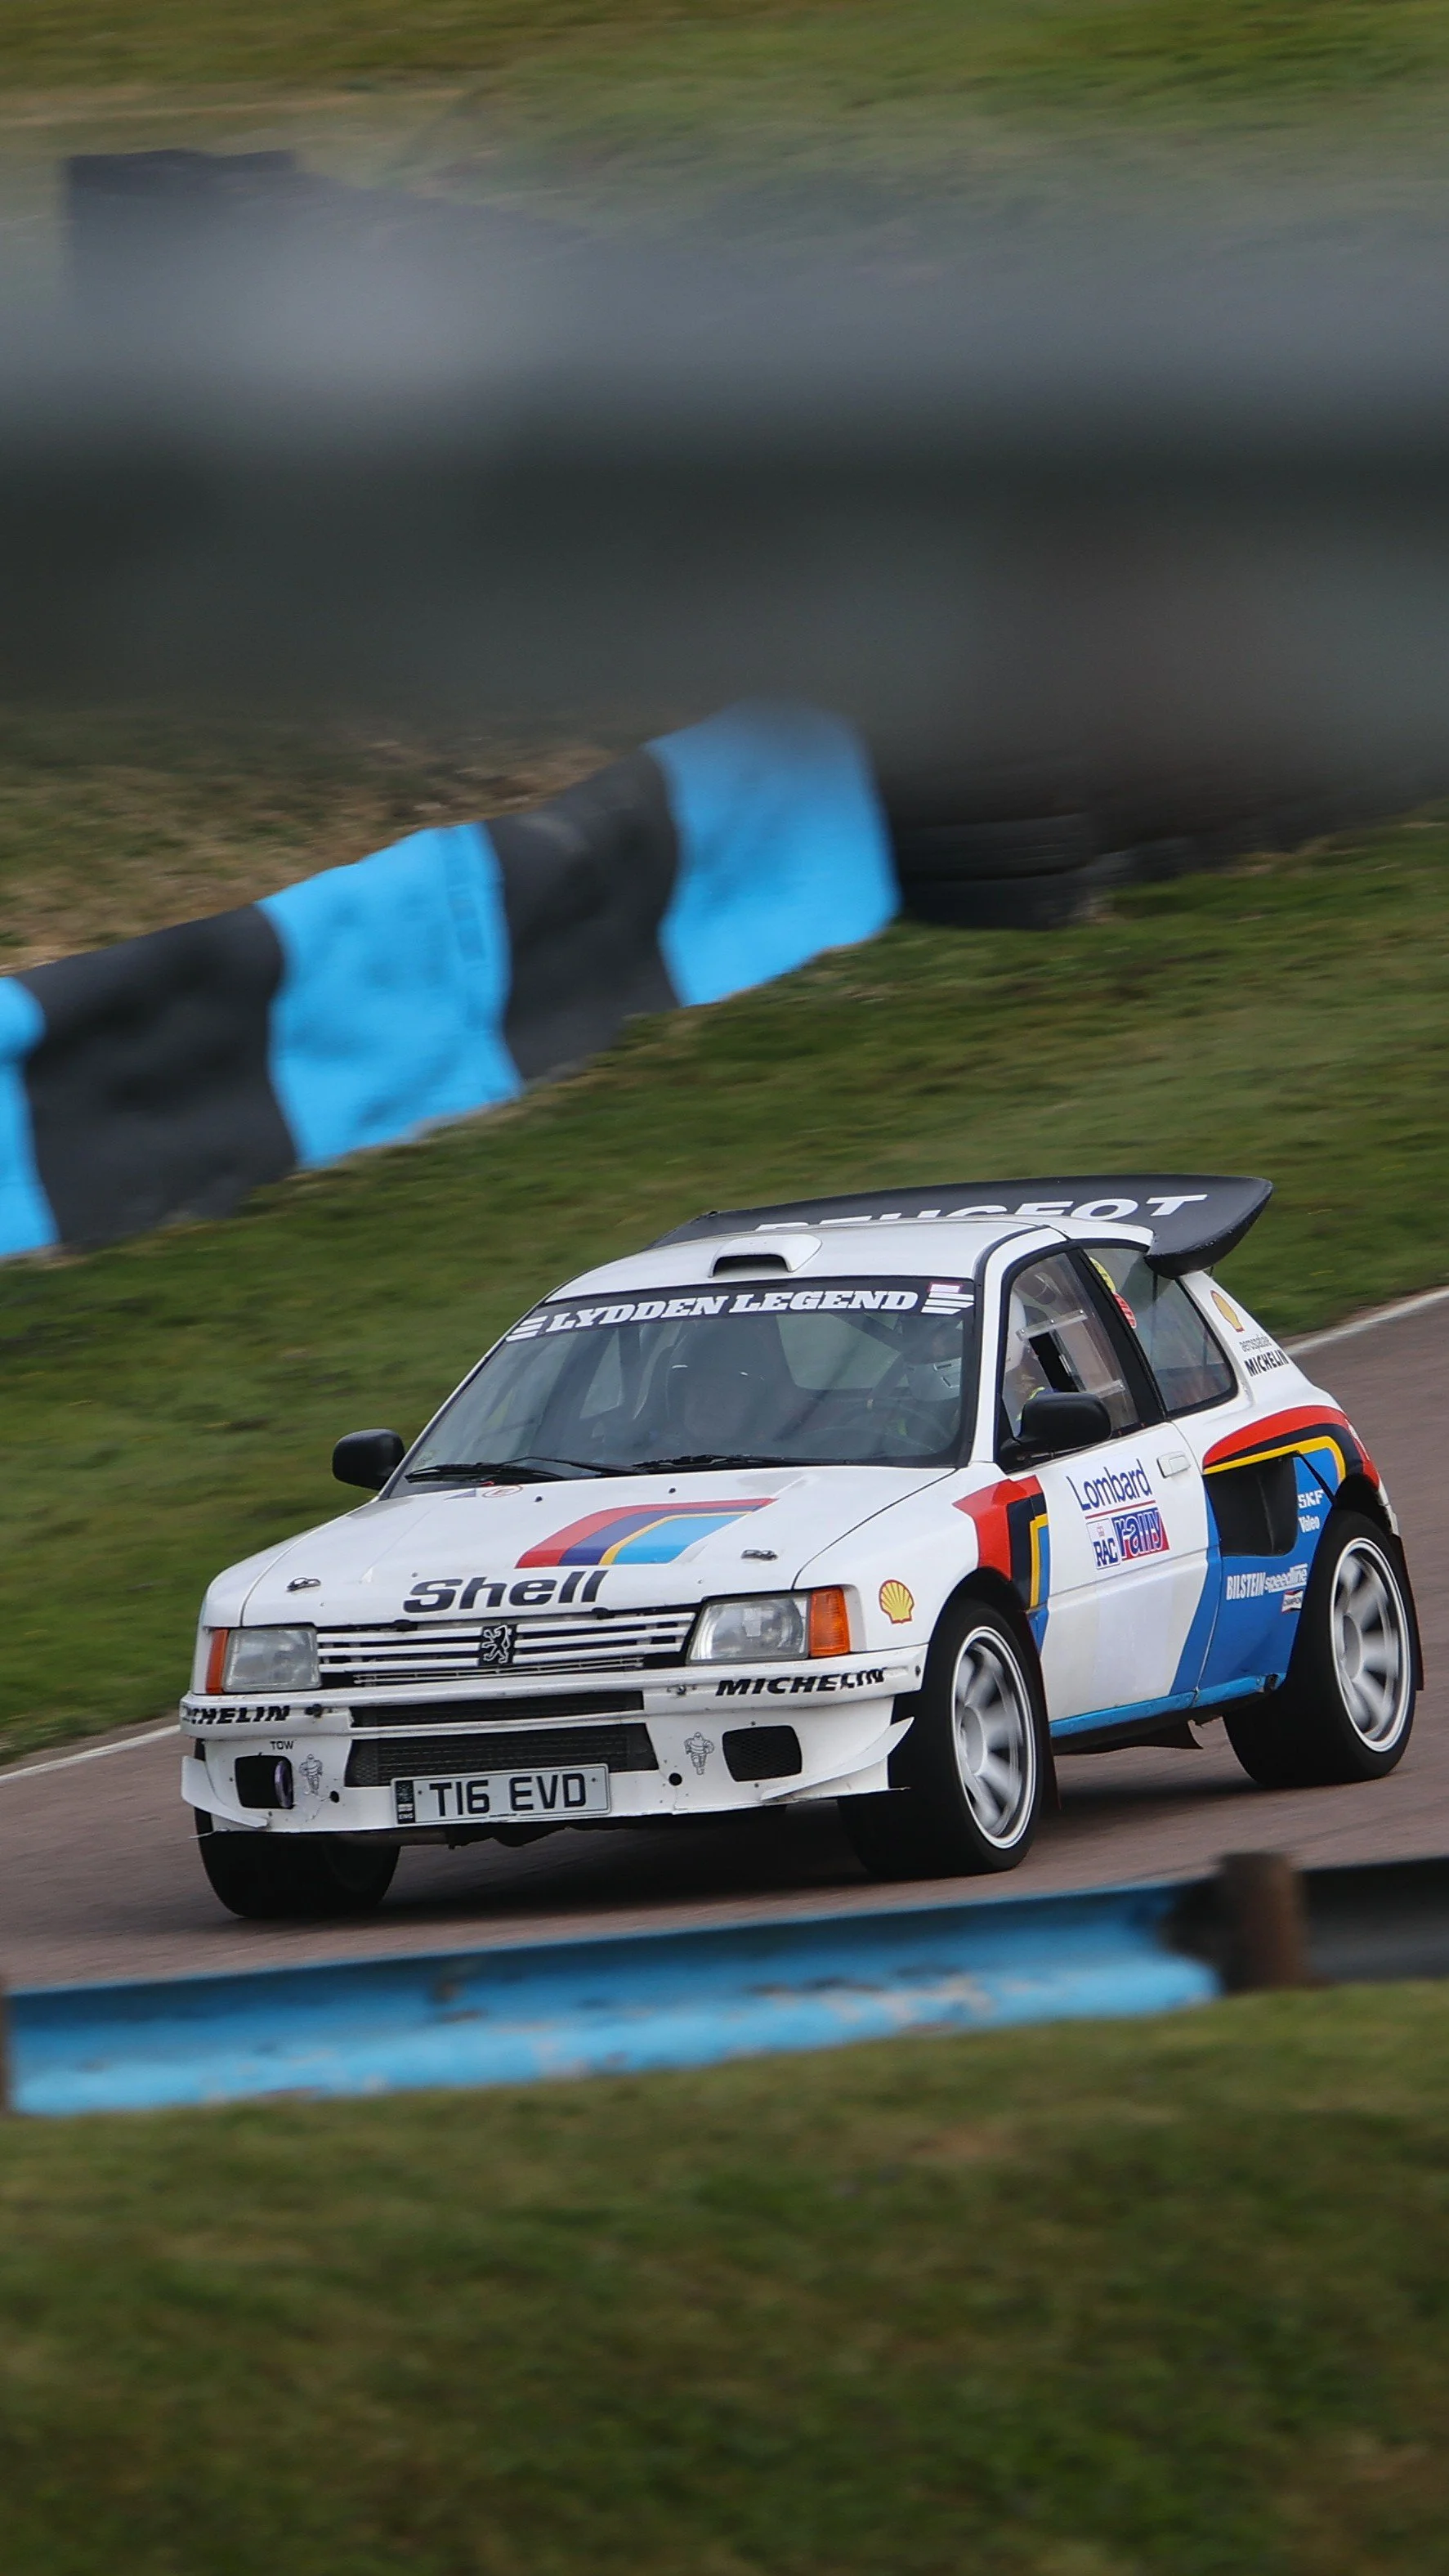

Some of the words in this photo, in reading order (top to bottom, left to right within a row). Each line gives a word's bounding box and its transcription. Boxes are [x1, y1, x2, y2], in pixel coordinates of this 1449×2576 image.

[545, 1295, 730, 1332] LYDDEN
[728, 1290, 919, 1314] LEGEND
[1244, 1349, 1290, 1377] MICHELIN
[1065, 1458, 1153, 1511] Lombard
[1298, 1489, 1324, 1508] SKF
[1093, 1537, 1120, 1566] RAC
[1115, 1511, 1164, 1558] rally
[403, 1570, 609, 1614] Shell
[1226, 1571, 1266, 1601] BILSTEIN
[715, 1667, 887, 1697] MICHELIN
[269, 1740, 294, 1750] TOW
[429, 1780, 490, 1817] T16
[509, 1772, 587, 1812] EVD
